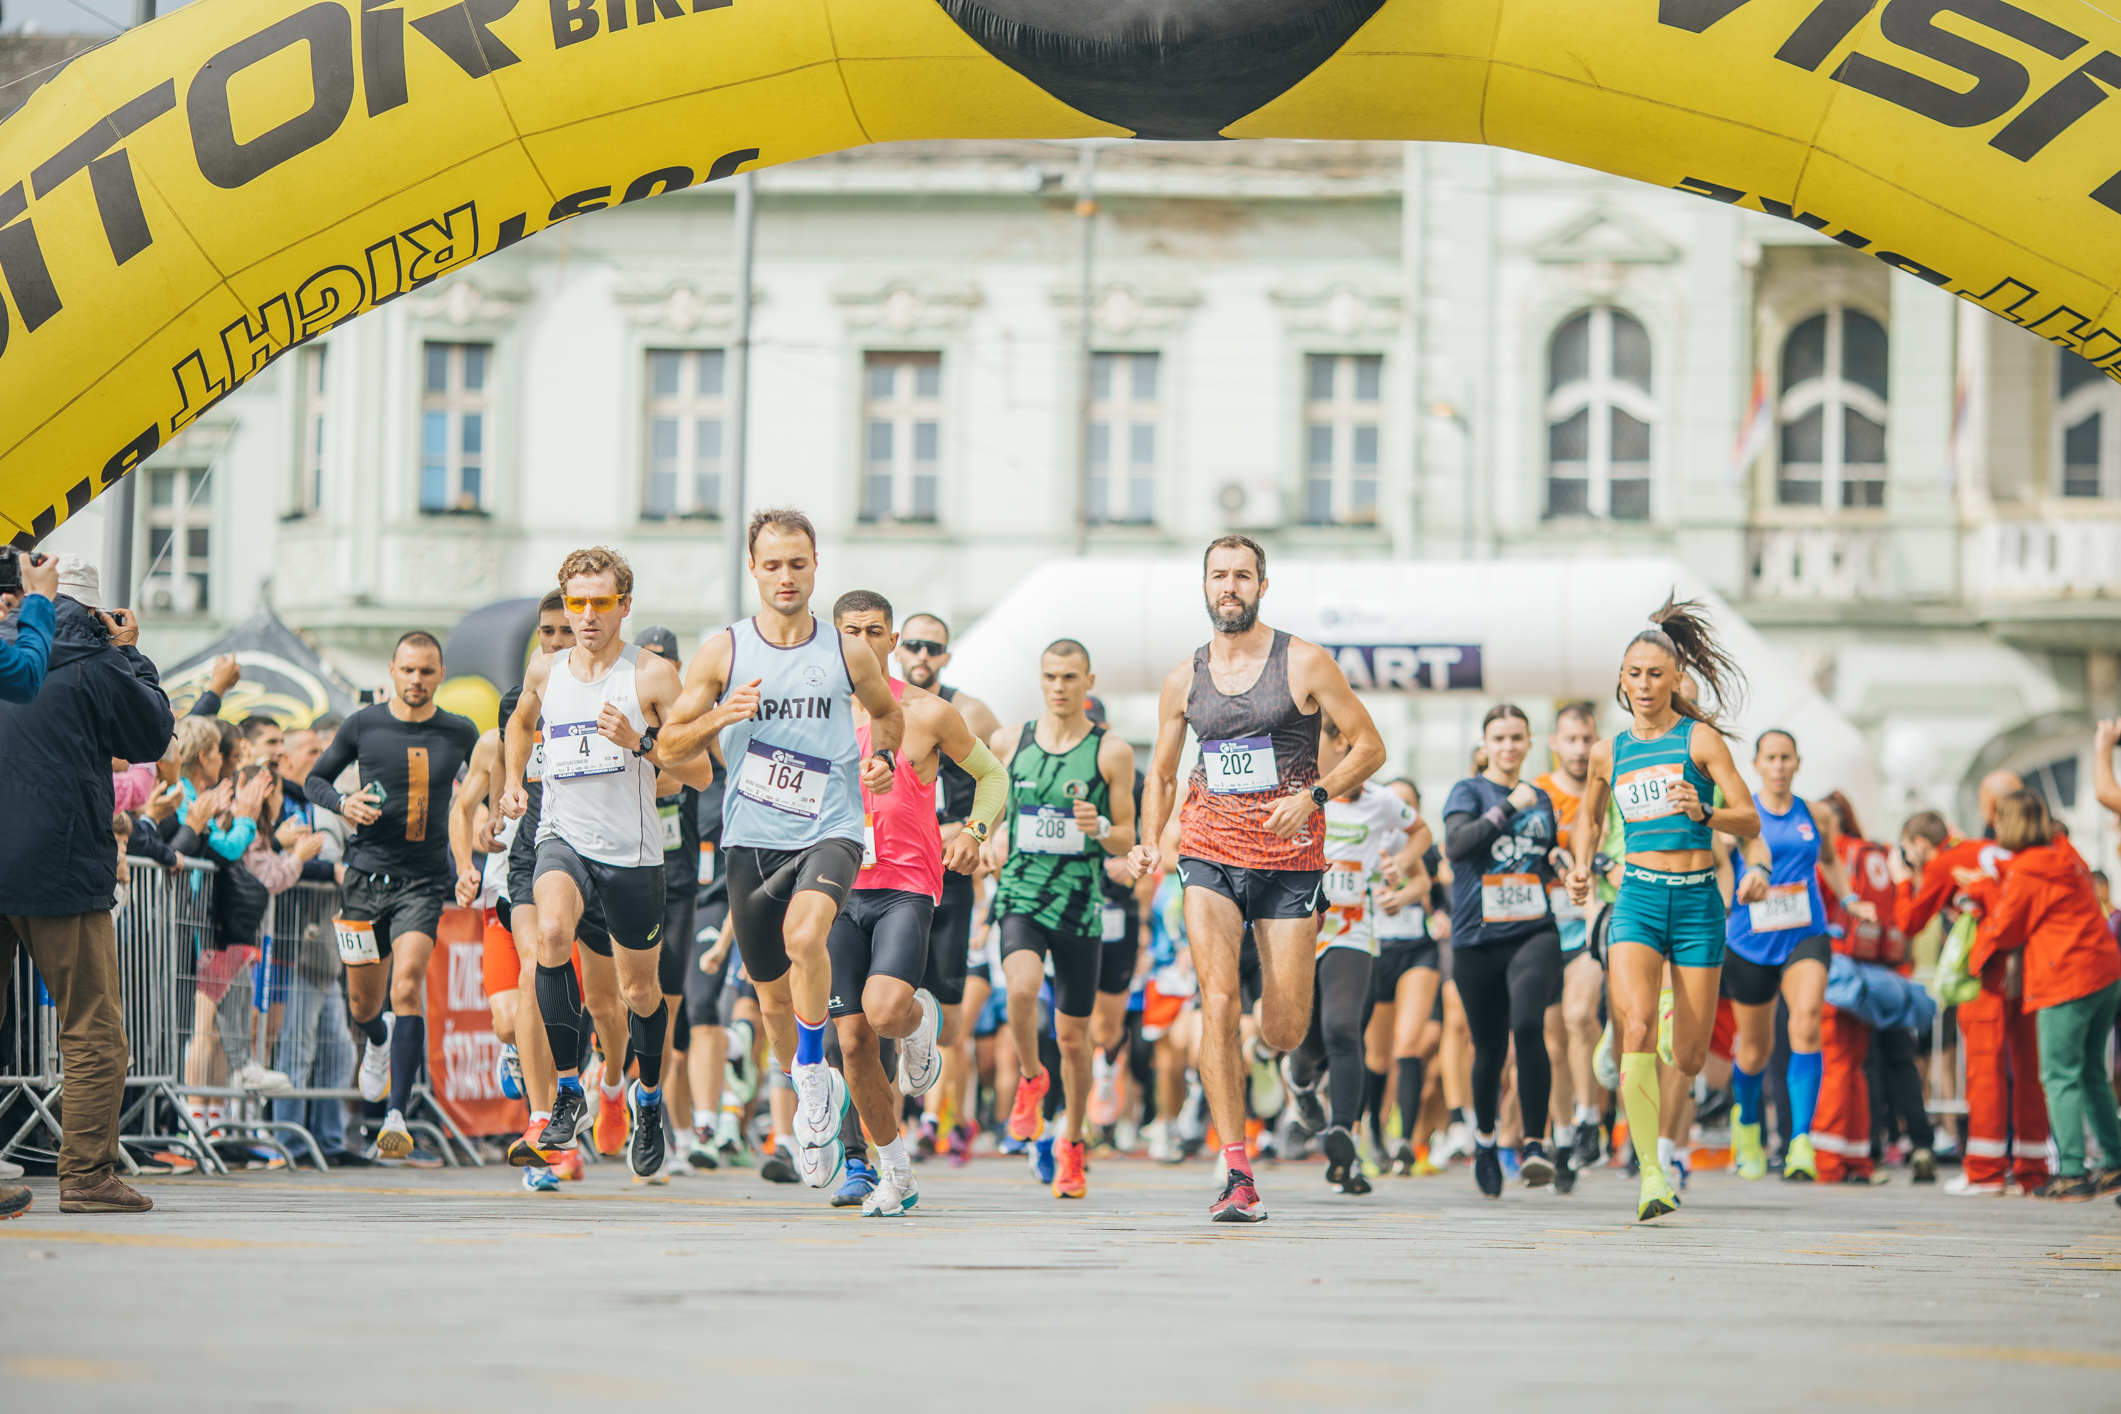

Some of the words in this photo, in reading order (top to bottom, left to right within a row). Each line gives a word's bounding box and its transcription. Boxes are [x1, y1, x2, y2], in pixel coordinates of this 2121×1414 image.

[1332, 646, 1463, 691] ART
[536, 744, 544, 764] 3
[579, 735, 591, 757] 4
[1220, 752, 1254, 776] 202
[768, 763, 805, 793] 164
[1036, 818, 1065, 839] 208
[1323, 872, 1354, 891] 116
